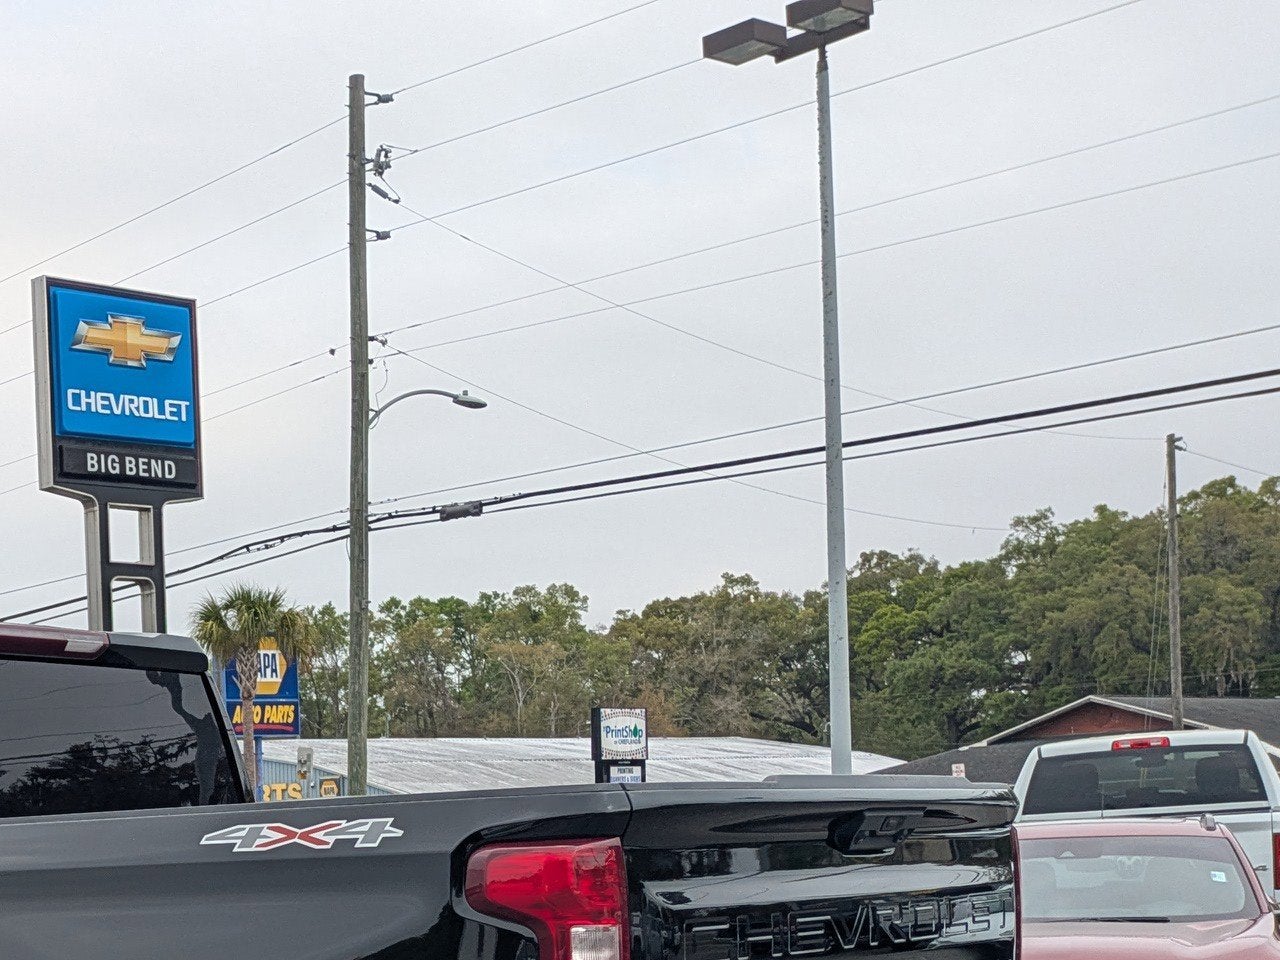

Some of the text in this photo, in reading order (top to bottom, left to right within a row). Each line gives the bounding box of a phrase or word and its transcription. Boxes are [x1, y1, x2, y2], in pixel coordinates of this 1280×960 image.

[67, 389, 190, 422] CHEVROLET
[86, 452, 176, 479] BIG BEND
[264, 704, 295, 724] PARTS
